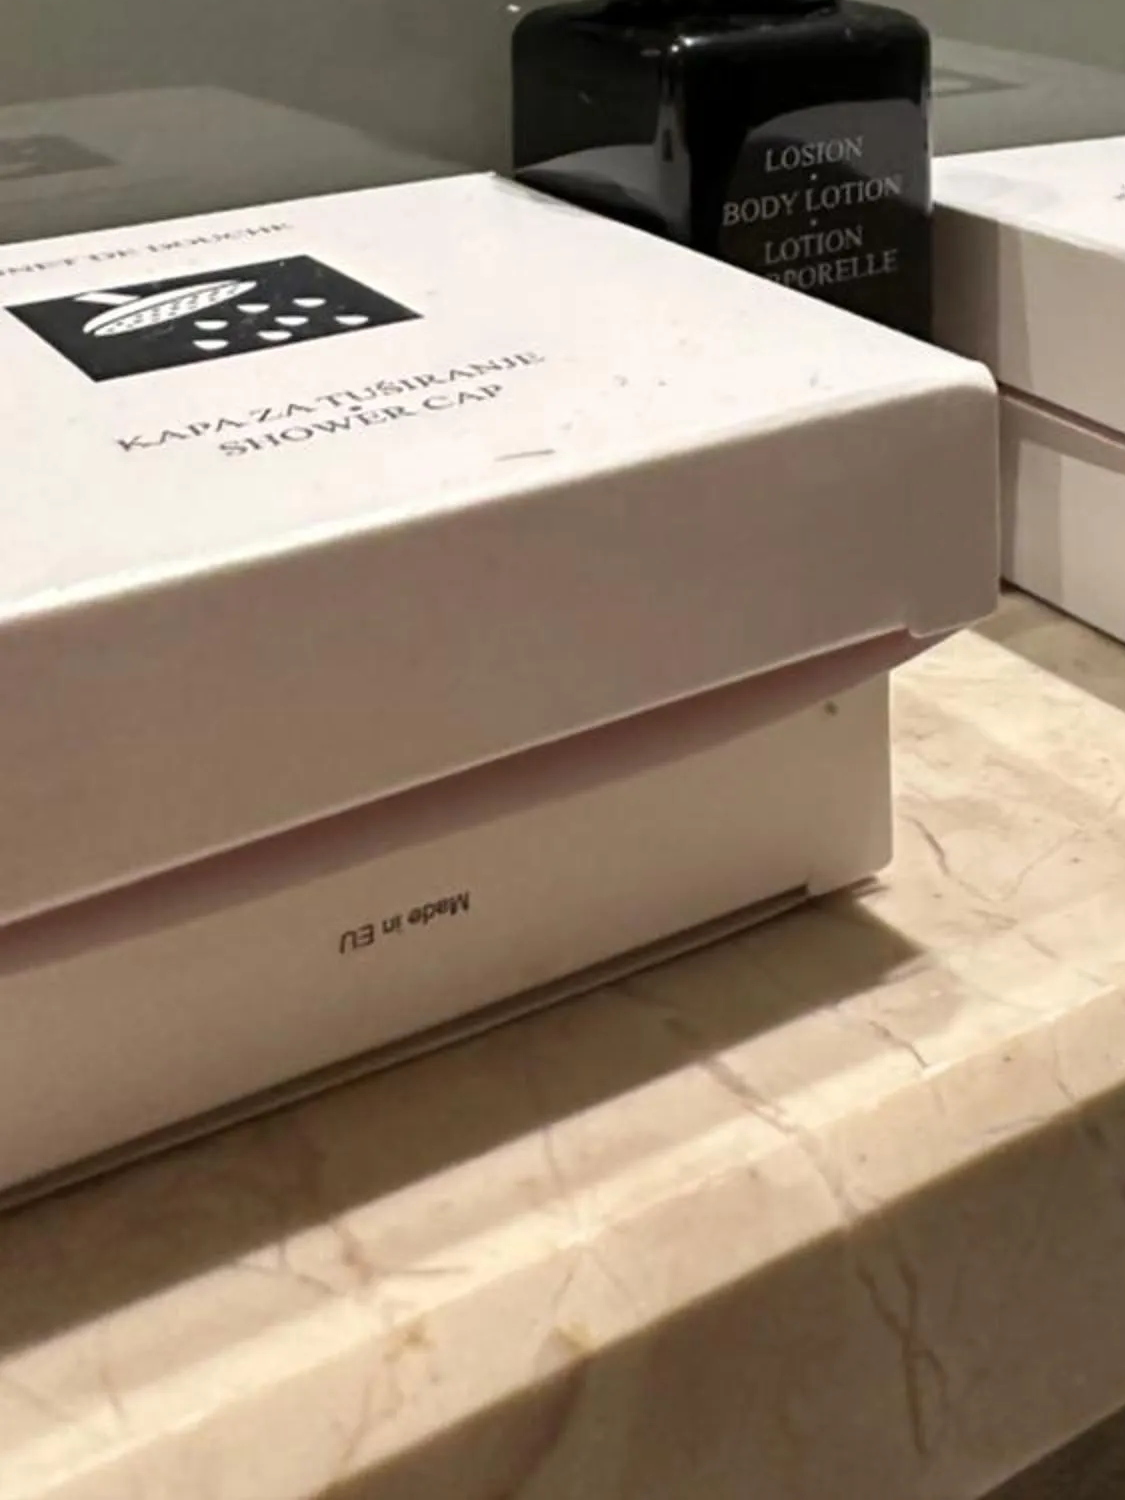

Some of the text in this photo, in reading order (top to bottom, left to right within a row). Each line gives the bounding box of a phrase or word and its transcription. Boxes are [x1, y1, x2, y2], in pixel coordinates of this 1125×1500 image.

[765, 135, 864, 173] LOSION
[722, 175, 901, 227] BODY LOTION
[764, 224, 864, 265] LOTION
[116, 417, 246, 452] KAPA
[249, 402, 316, 423] ZA
[218, 382, 504, 457] SHOWER CAP
[338, 890, 471, 955] Made in EU
